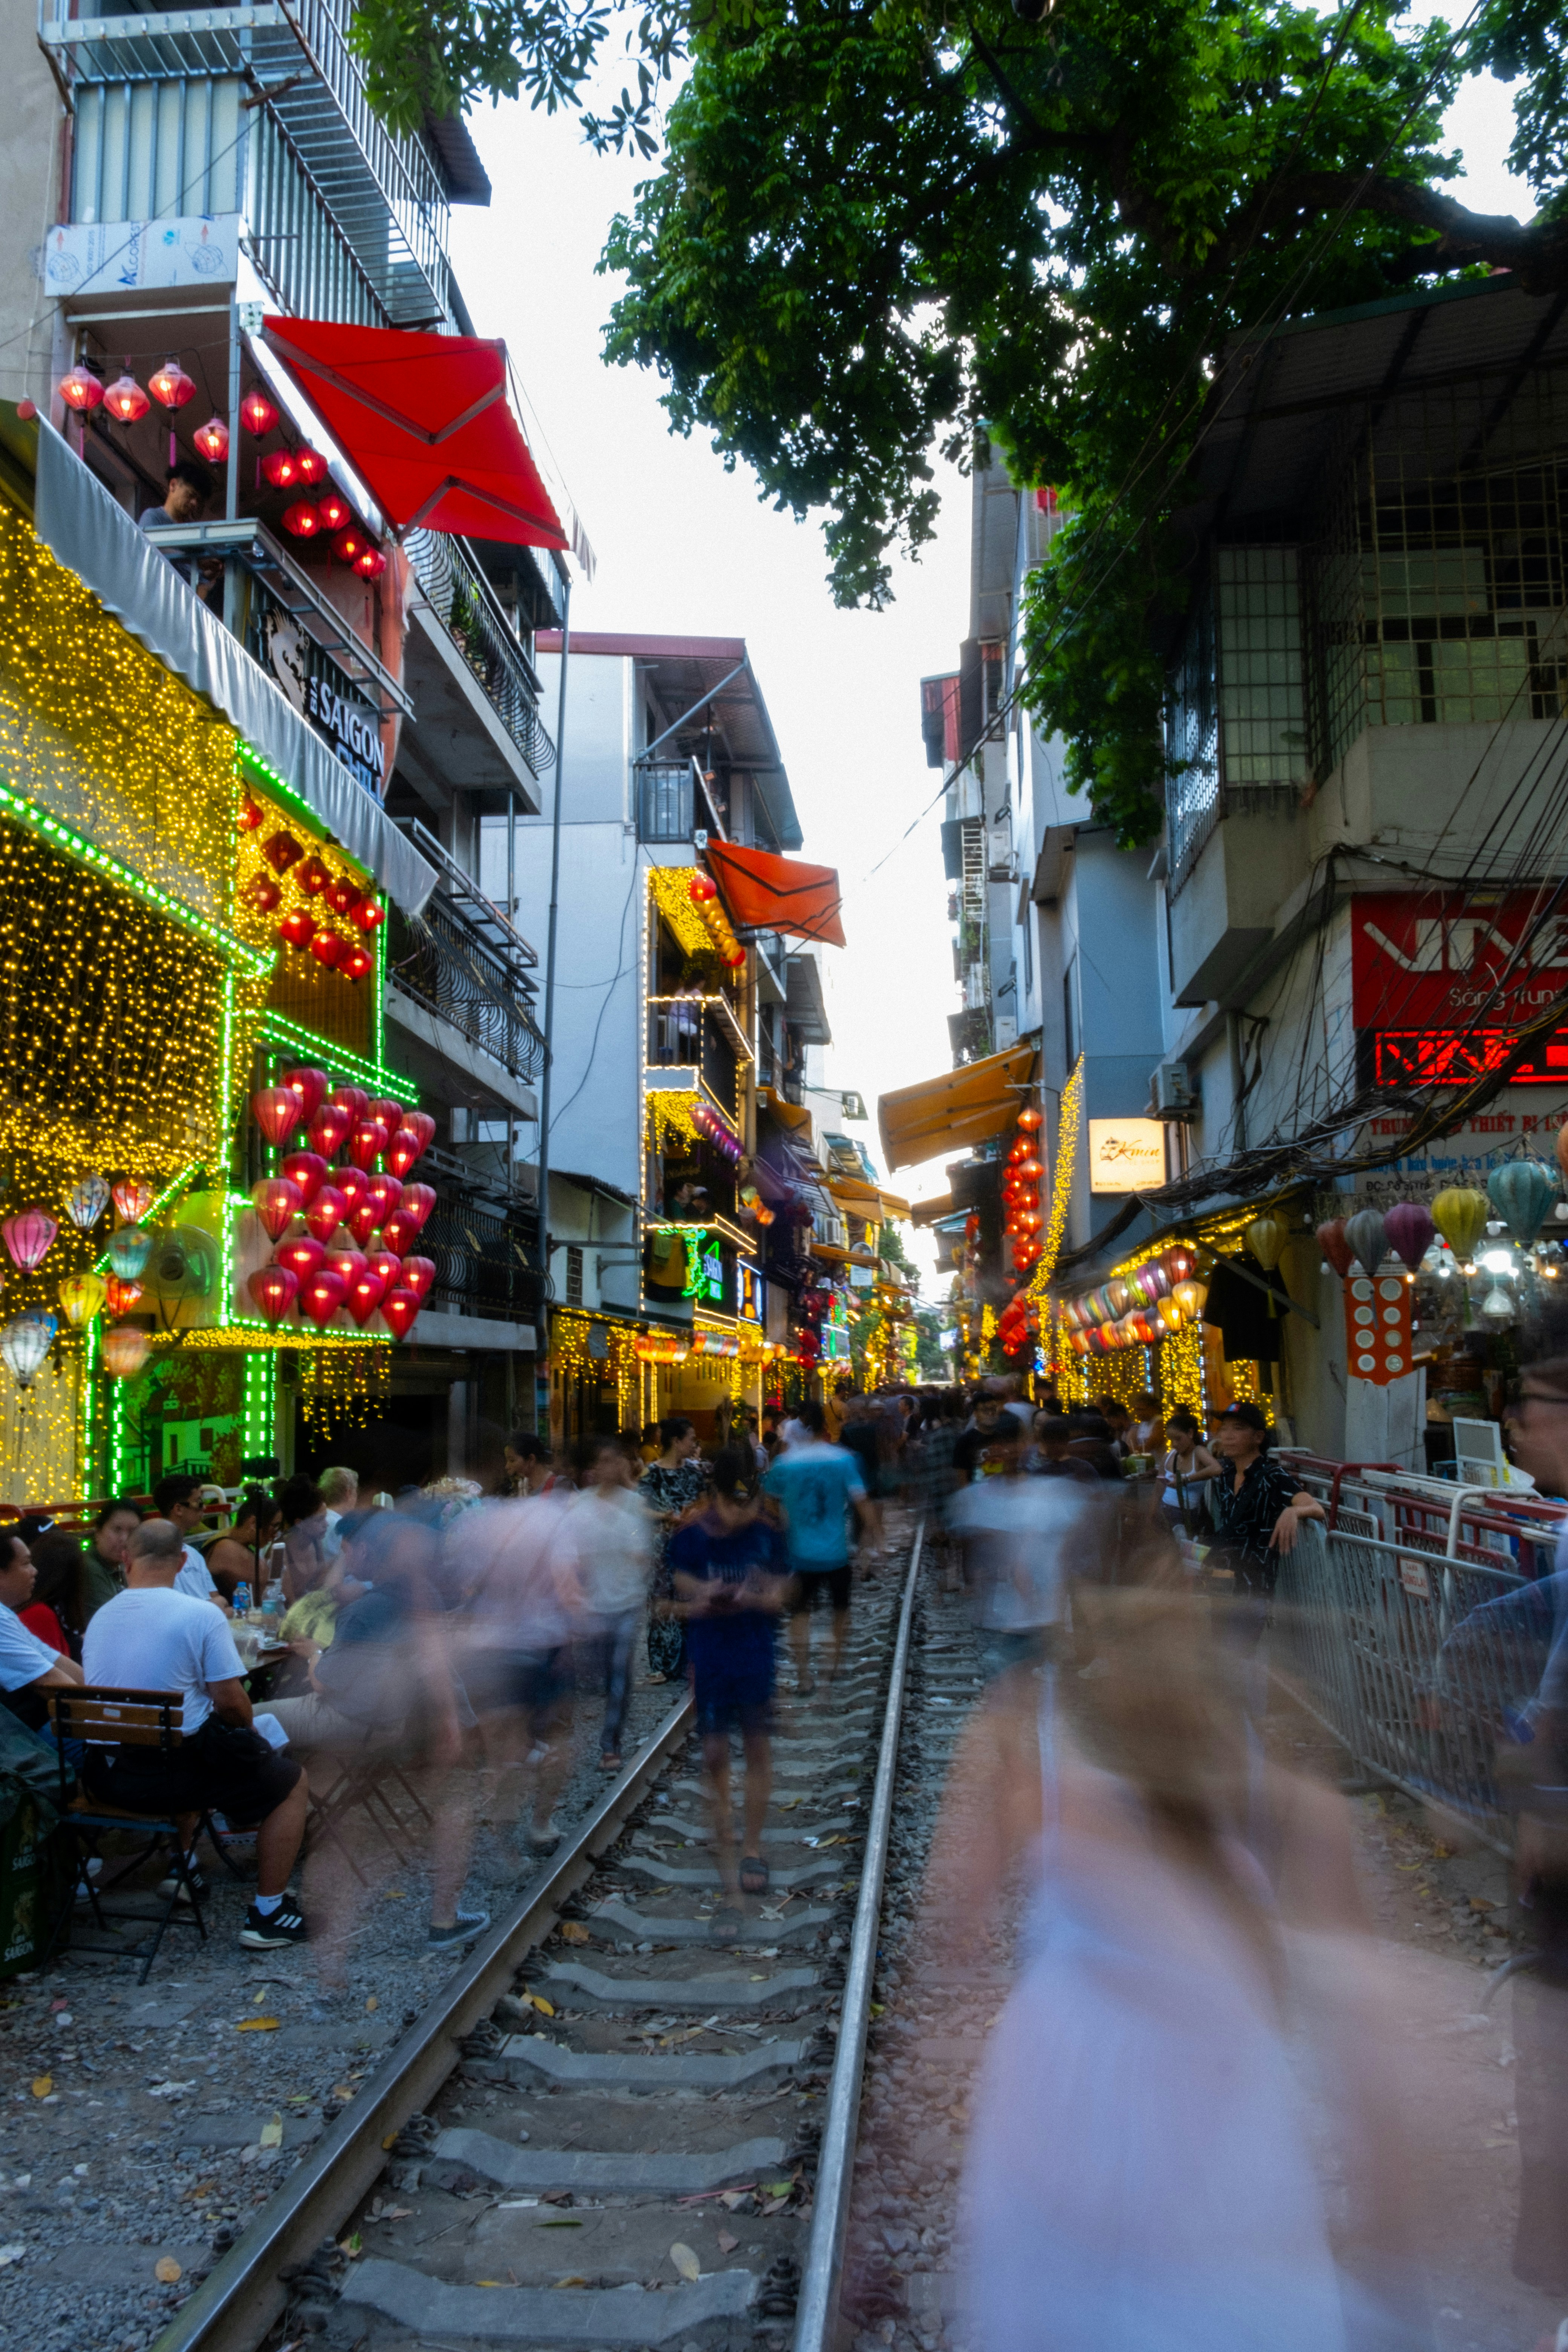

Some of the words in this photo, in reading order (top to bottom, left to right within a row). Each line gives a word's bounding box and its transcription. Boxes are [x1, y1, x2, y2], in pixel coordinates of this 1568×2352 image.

[310, 676, 318, 715] BIA
[320, 682, 385, 777] SAIGON
[1470, 1110, 1516, 1133] THIẾT
